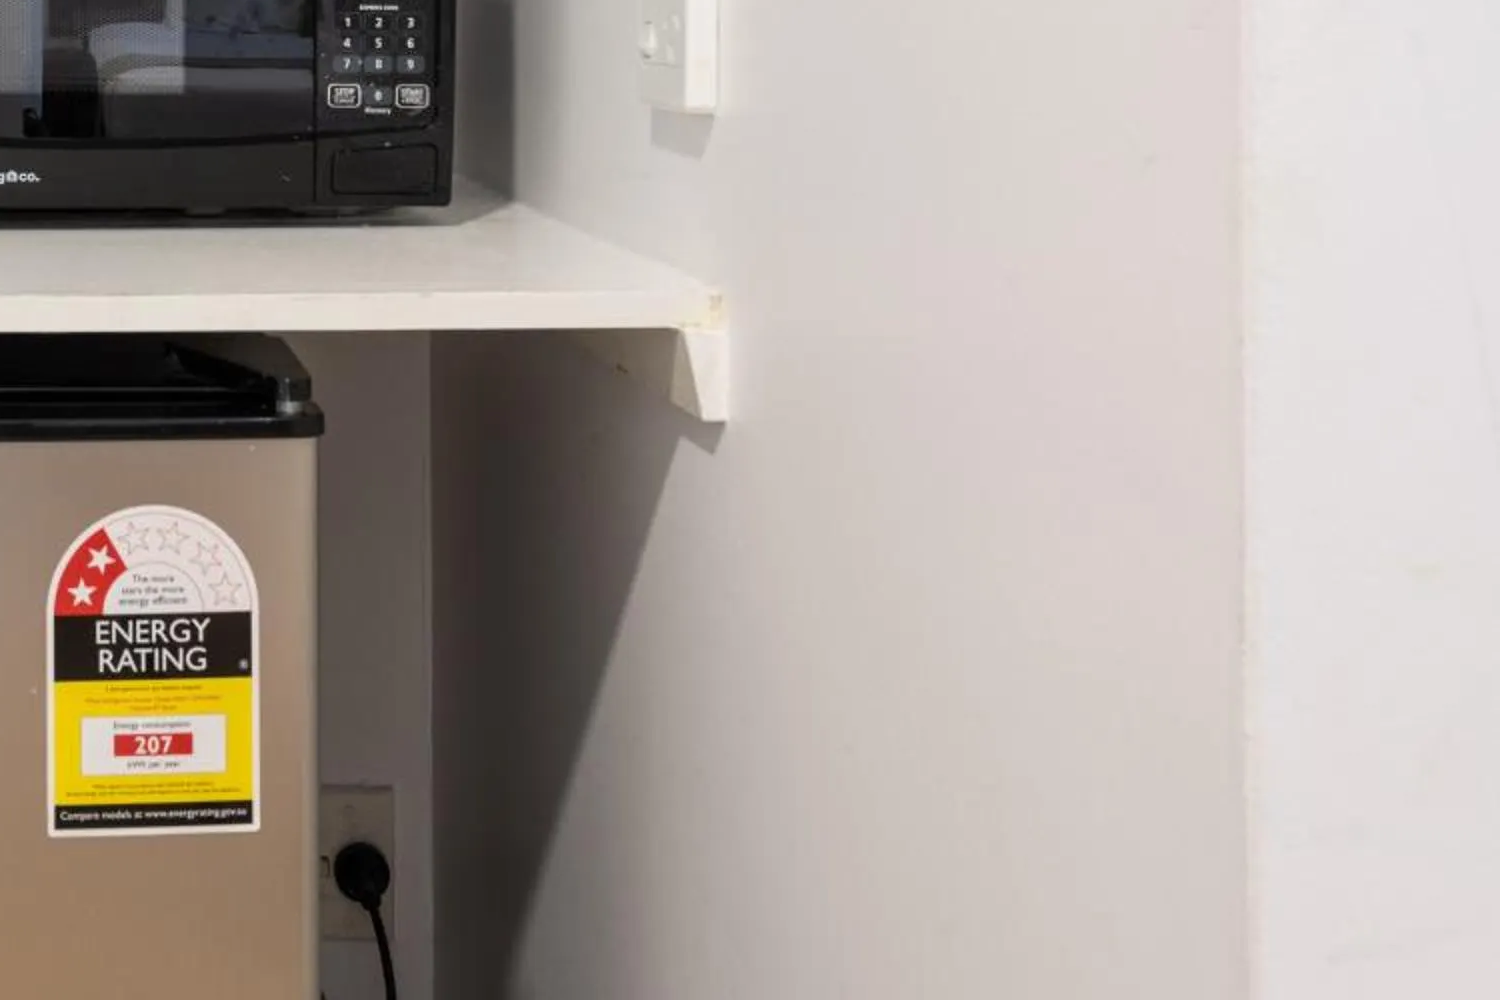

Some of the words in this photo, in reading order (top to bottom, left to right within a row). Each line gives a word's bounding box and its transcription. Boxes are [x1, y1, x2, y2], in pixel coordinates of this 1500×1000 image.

[344, 17, 351, 28] 1
[375, 17, 383, 29] 2
[407, 17, 415, 29] 3
[343, 37, 351, 49] 4
[375, 37, 383, 49] 5
[407, 37, 415, 49] 6
[343, 57, 351, 69] 7
[375, 58, 383, 69] 8
[407, 58, 415, 69] 9
[94, 617, 211, 645] ENERGY
[98, 646, 208, 673] RATING
[134, 736, 173, 755] 207
[59, 811, 100, 823] Compare
[102, 810, 133, 821] models
[134, 810, 144, 819] at
